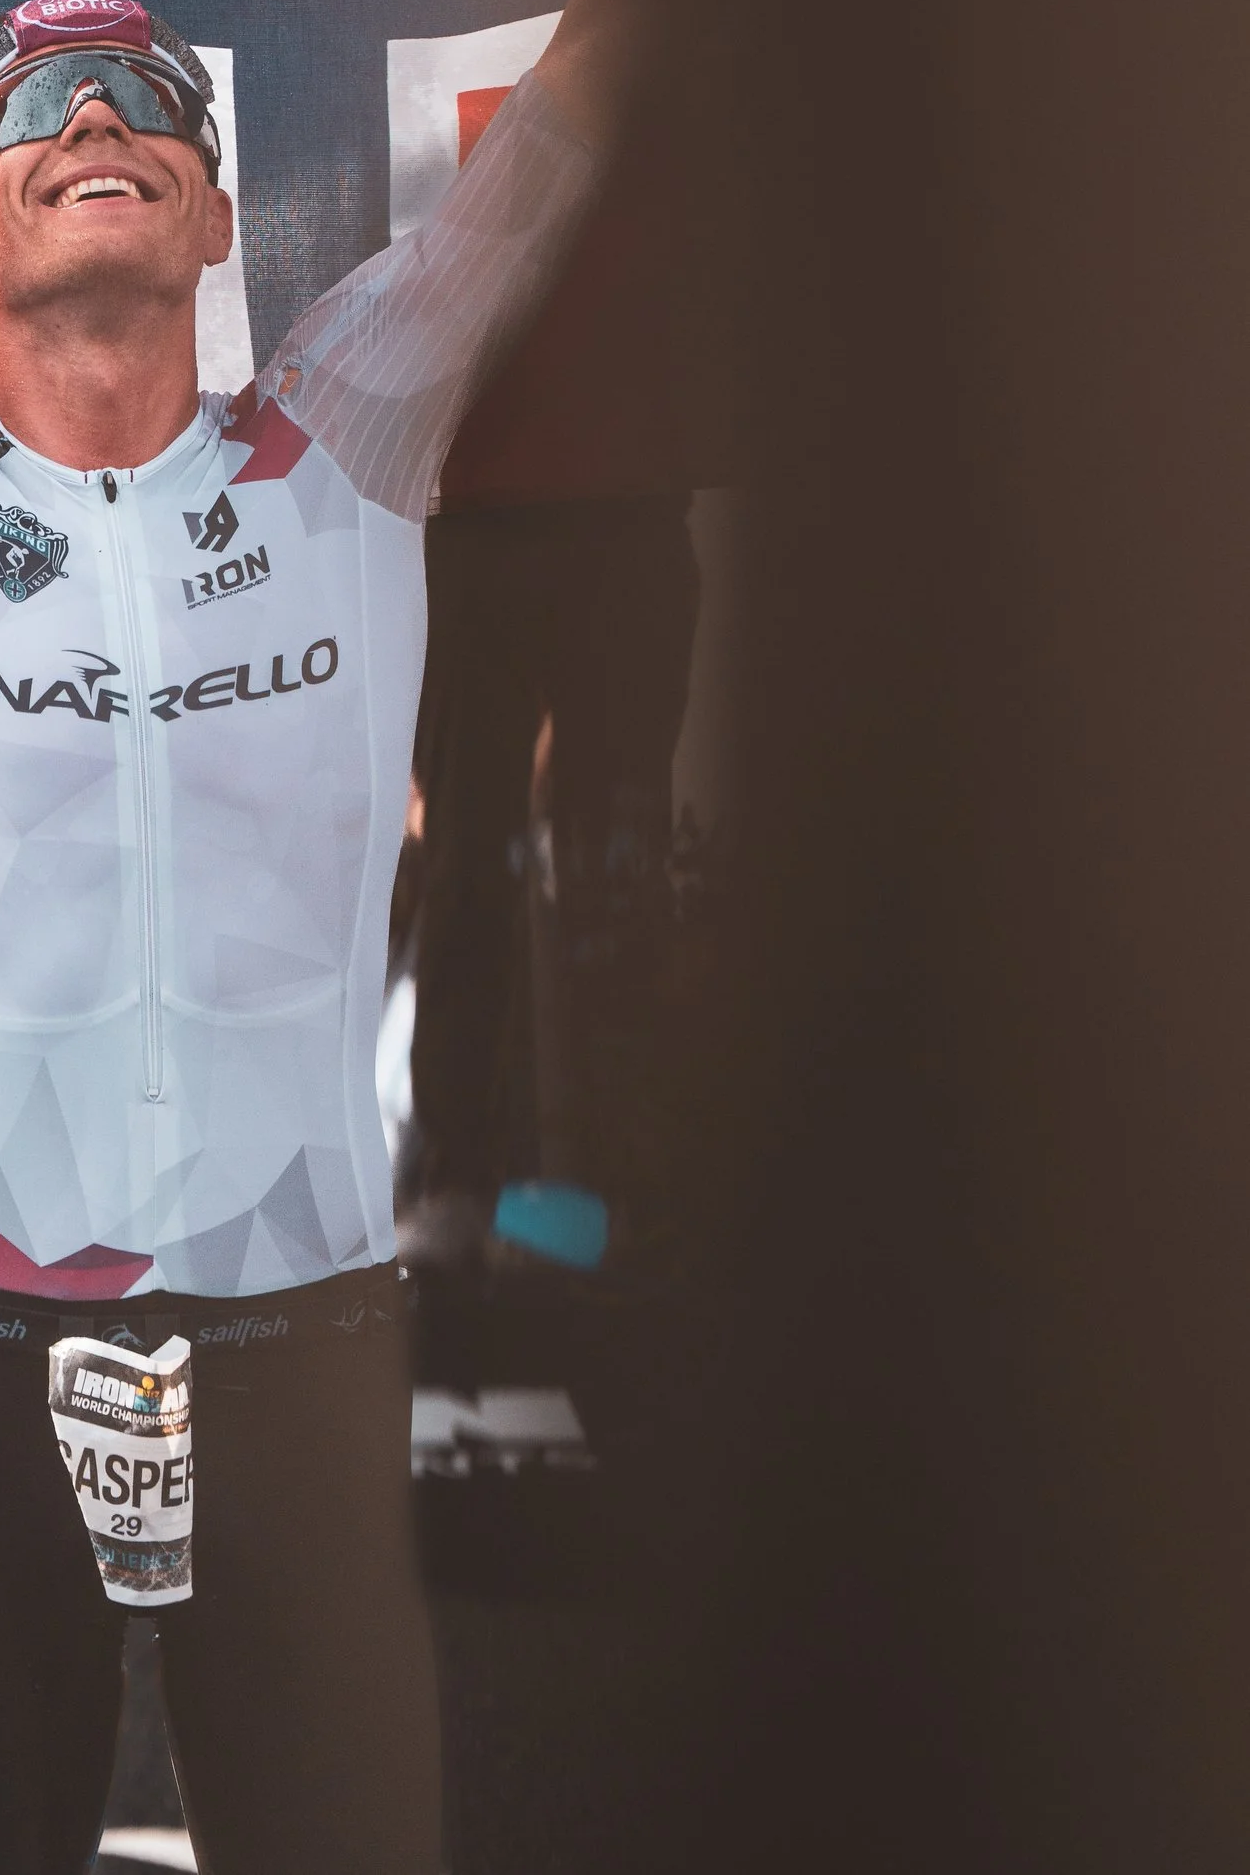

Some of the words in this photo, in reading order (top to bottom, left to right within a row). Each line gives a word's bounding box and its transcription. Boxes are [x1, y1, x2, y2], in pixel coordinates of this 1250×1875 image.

[27, 571, 51, 591] 1892
[181, 544, 271, 604] IRON
[187, 595, 217, 611] SPORT
[217, 573, 272, 601] MANAGEMENT
[197, 1313, 289, 1347] sailfish
[71, 1394, 111, 1416] WORLD
[111, 1407, 190, 1427] CHAMPIONSHIP
[110, 1513, 143, 1537] 29
